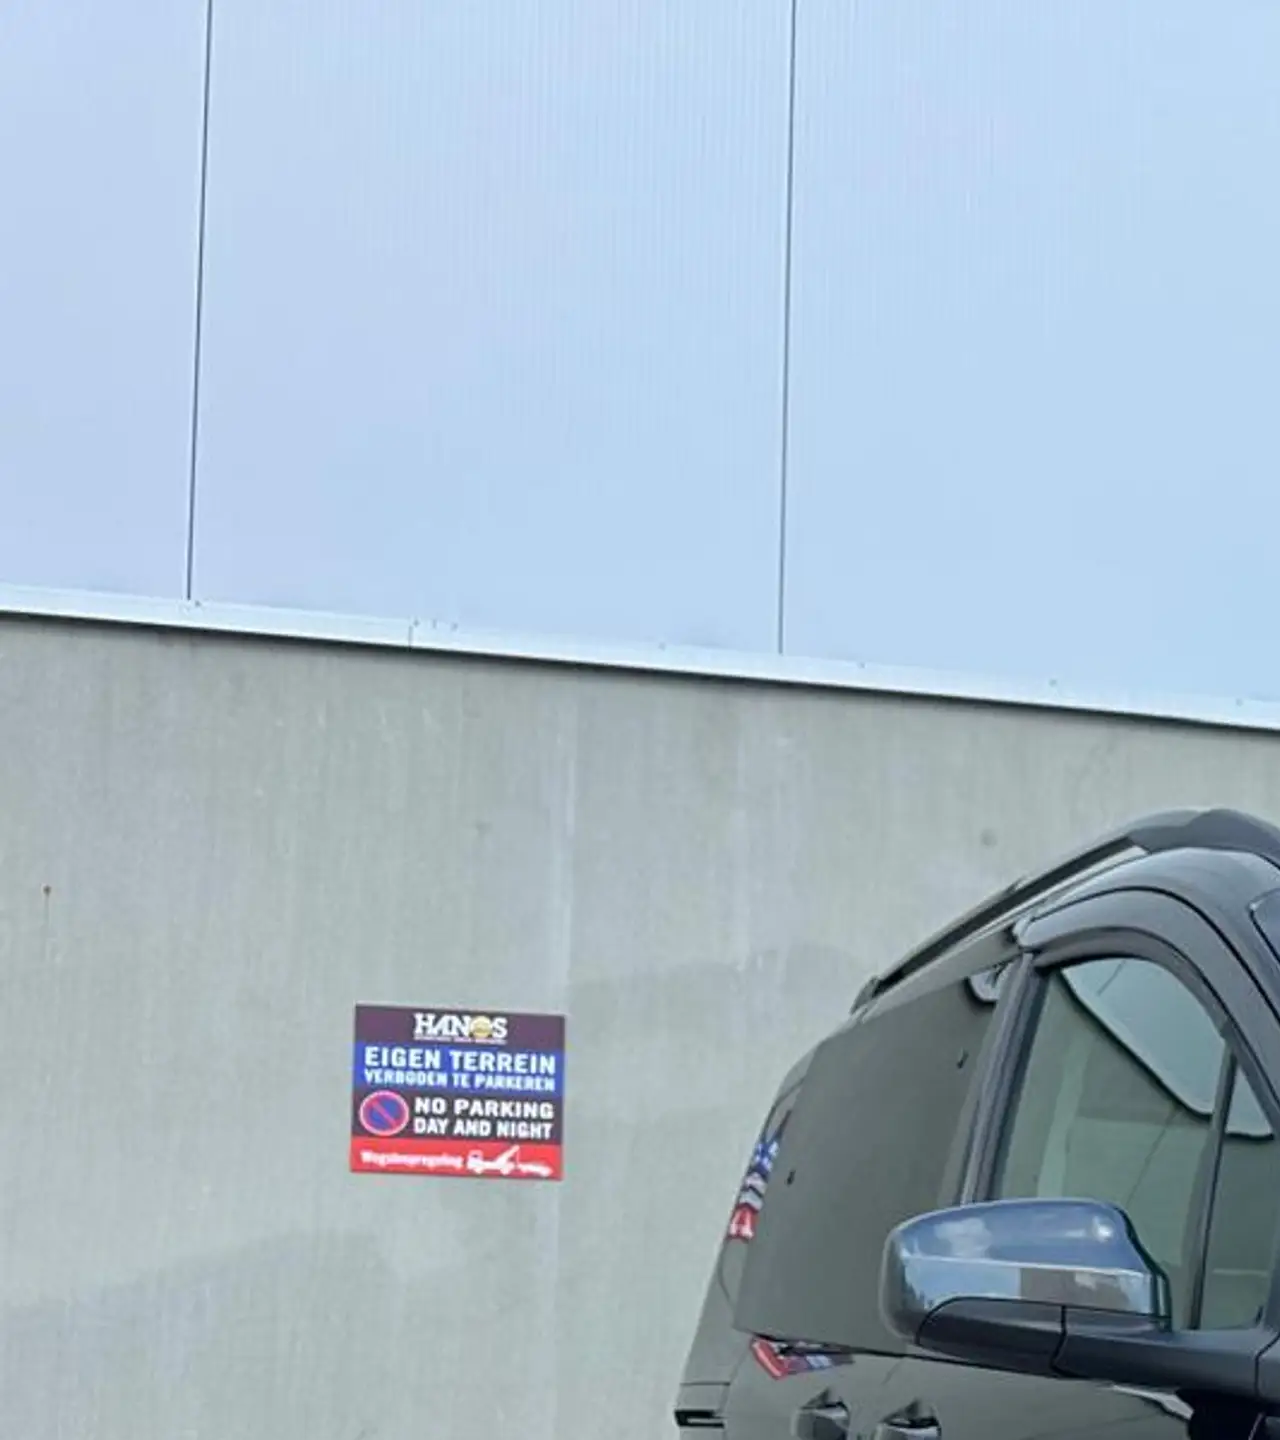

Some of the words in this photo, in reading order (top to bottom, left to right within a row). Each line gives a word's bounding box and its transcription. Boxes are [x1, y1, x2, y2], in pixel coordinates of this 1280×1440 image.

[364, 1046, 441, 1069] EIGEN
[449, 1051, 555, 1074] TERREIN
[364, 1069, 448, 1087] VERBODEN
[452, 1073, 470, 1088] TE
[474, 1074, 555, 1091] PARKEREN
[414, 1097, 447, 1115] NO
[454, 1099, 554, 1119] PARKING
[413, 1117, 449, 1135] DAY
[453, 1120, 491, 1137] AND
[496, 1122, 554, 1140] NIGHT
